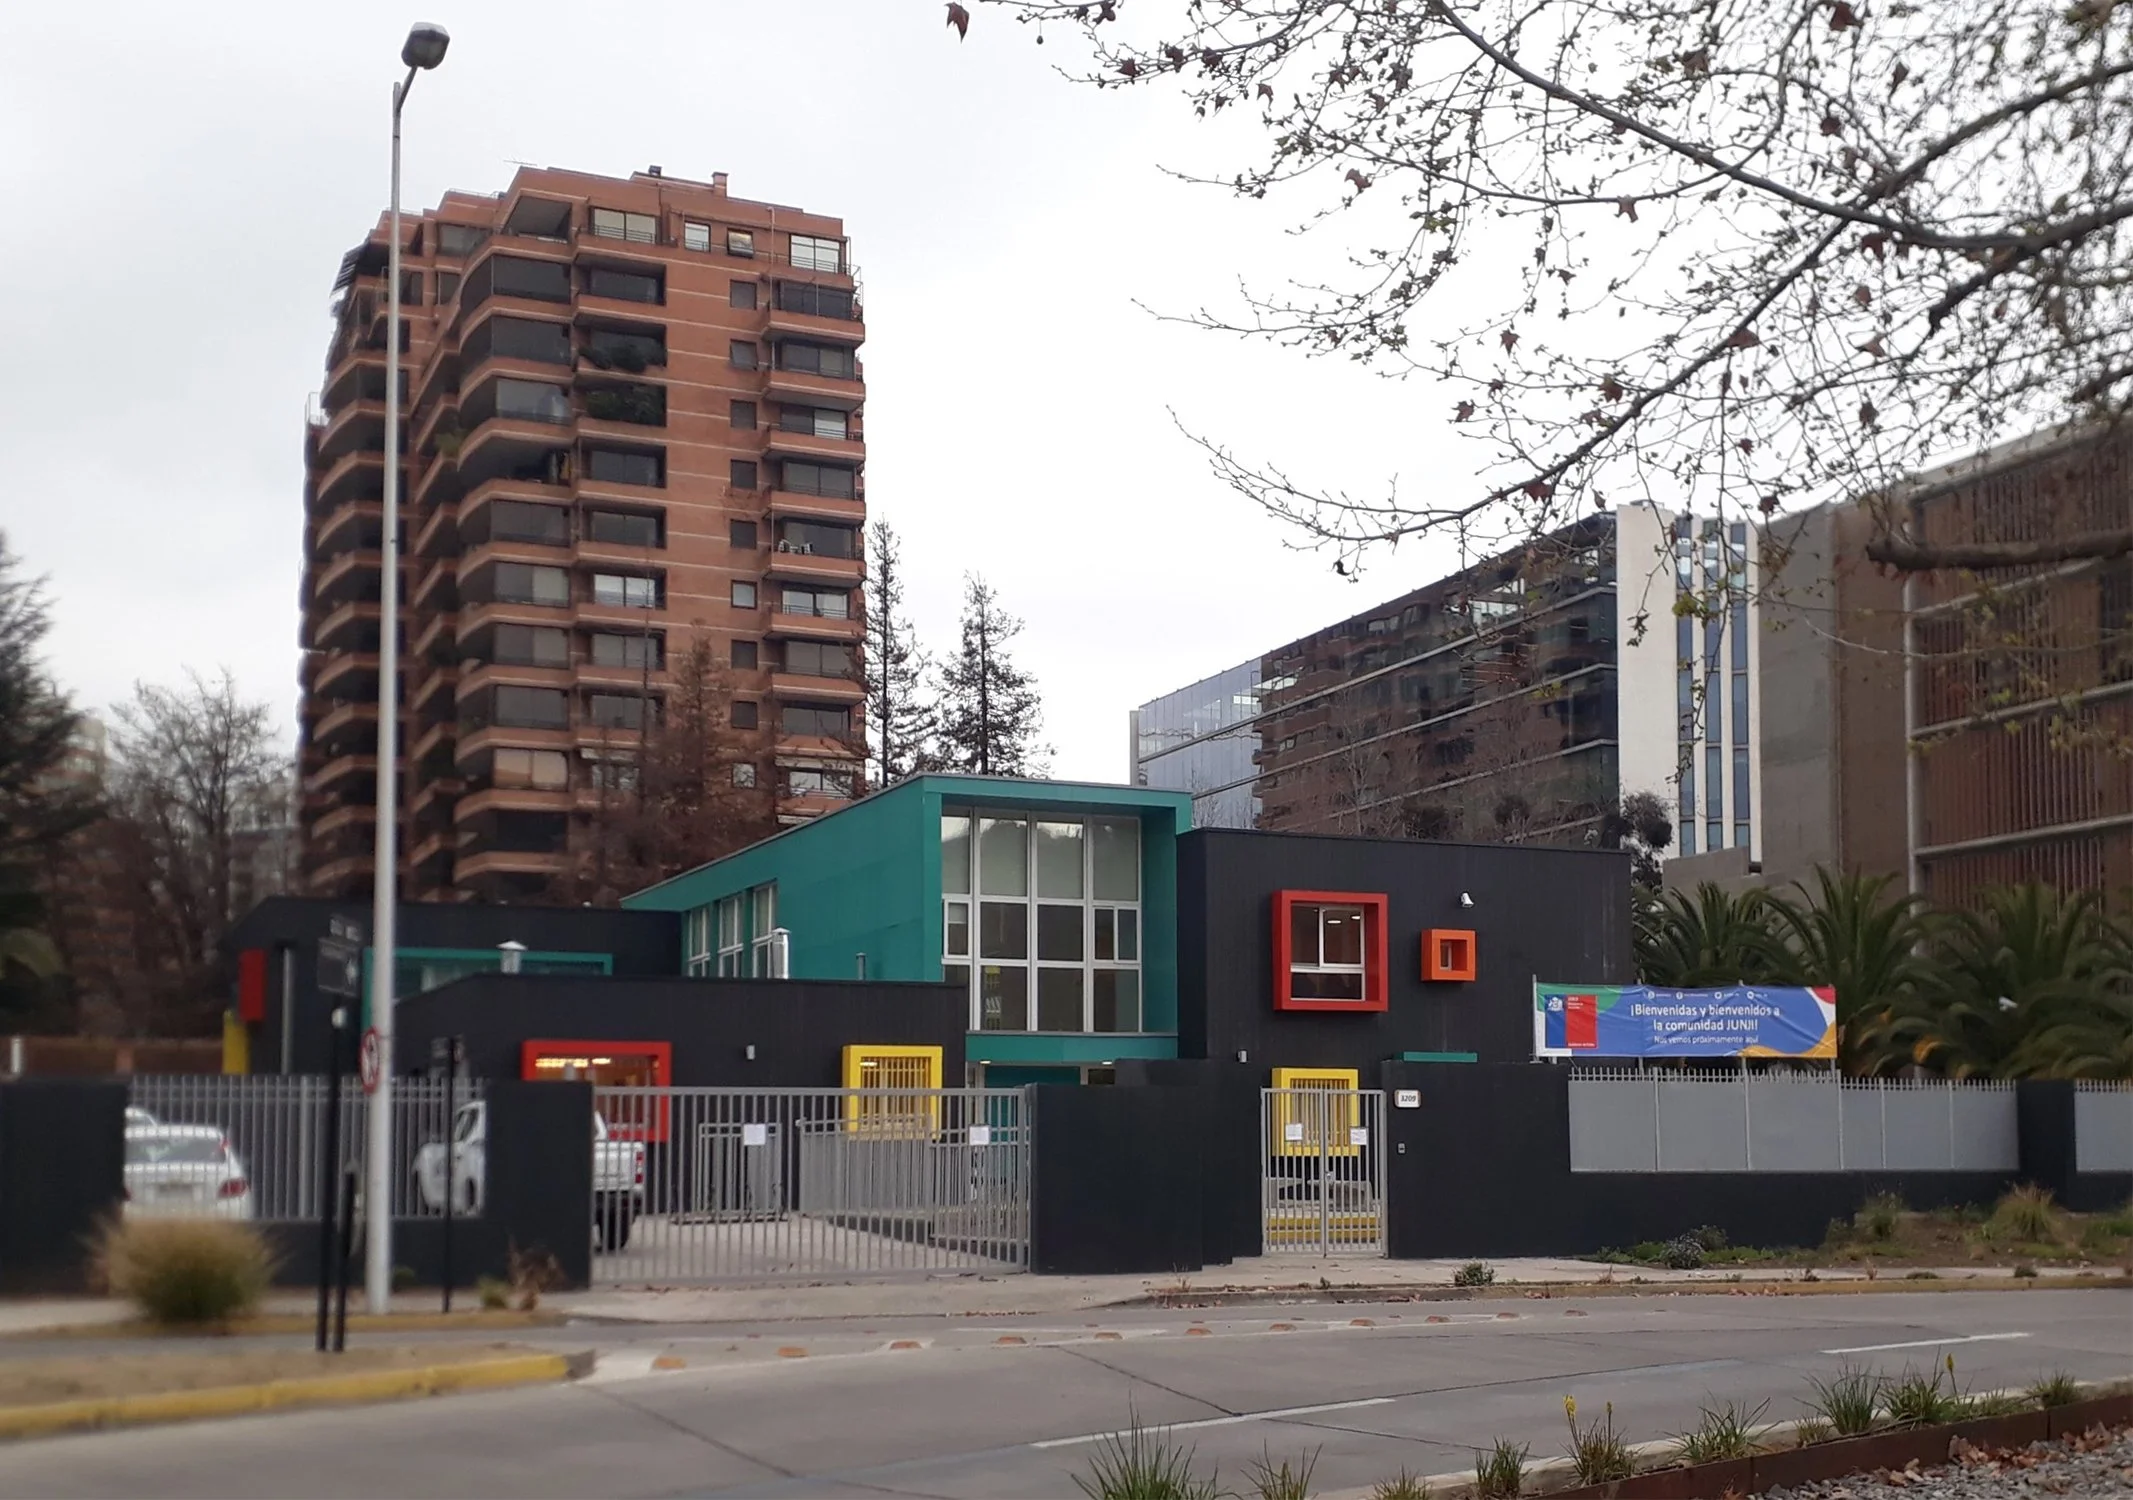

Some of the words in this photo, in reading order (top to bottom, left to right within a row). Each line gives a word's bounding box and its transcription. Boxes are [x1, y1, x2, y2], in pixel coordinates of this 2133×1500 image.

[1631, 1004, 1697, 1016] ¡Bienvenidas
[1699, 1007, 1706, 1017] y
[1709, 1004, 1771, 1016] bienvenidos
[1773, 1007, 1780, 1016] a
[1653, 1019, 1663, 1031] la
[1665, 1019, 1724, 1031] comunidad
[1726, 1019, 1758, 1031] JUNJI!
[1668, 1036, 1691, 1044] vemos
